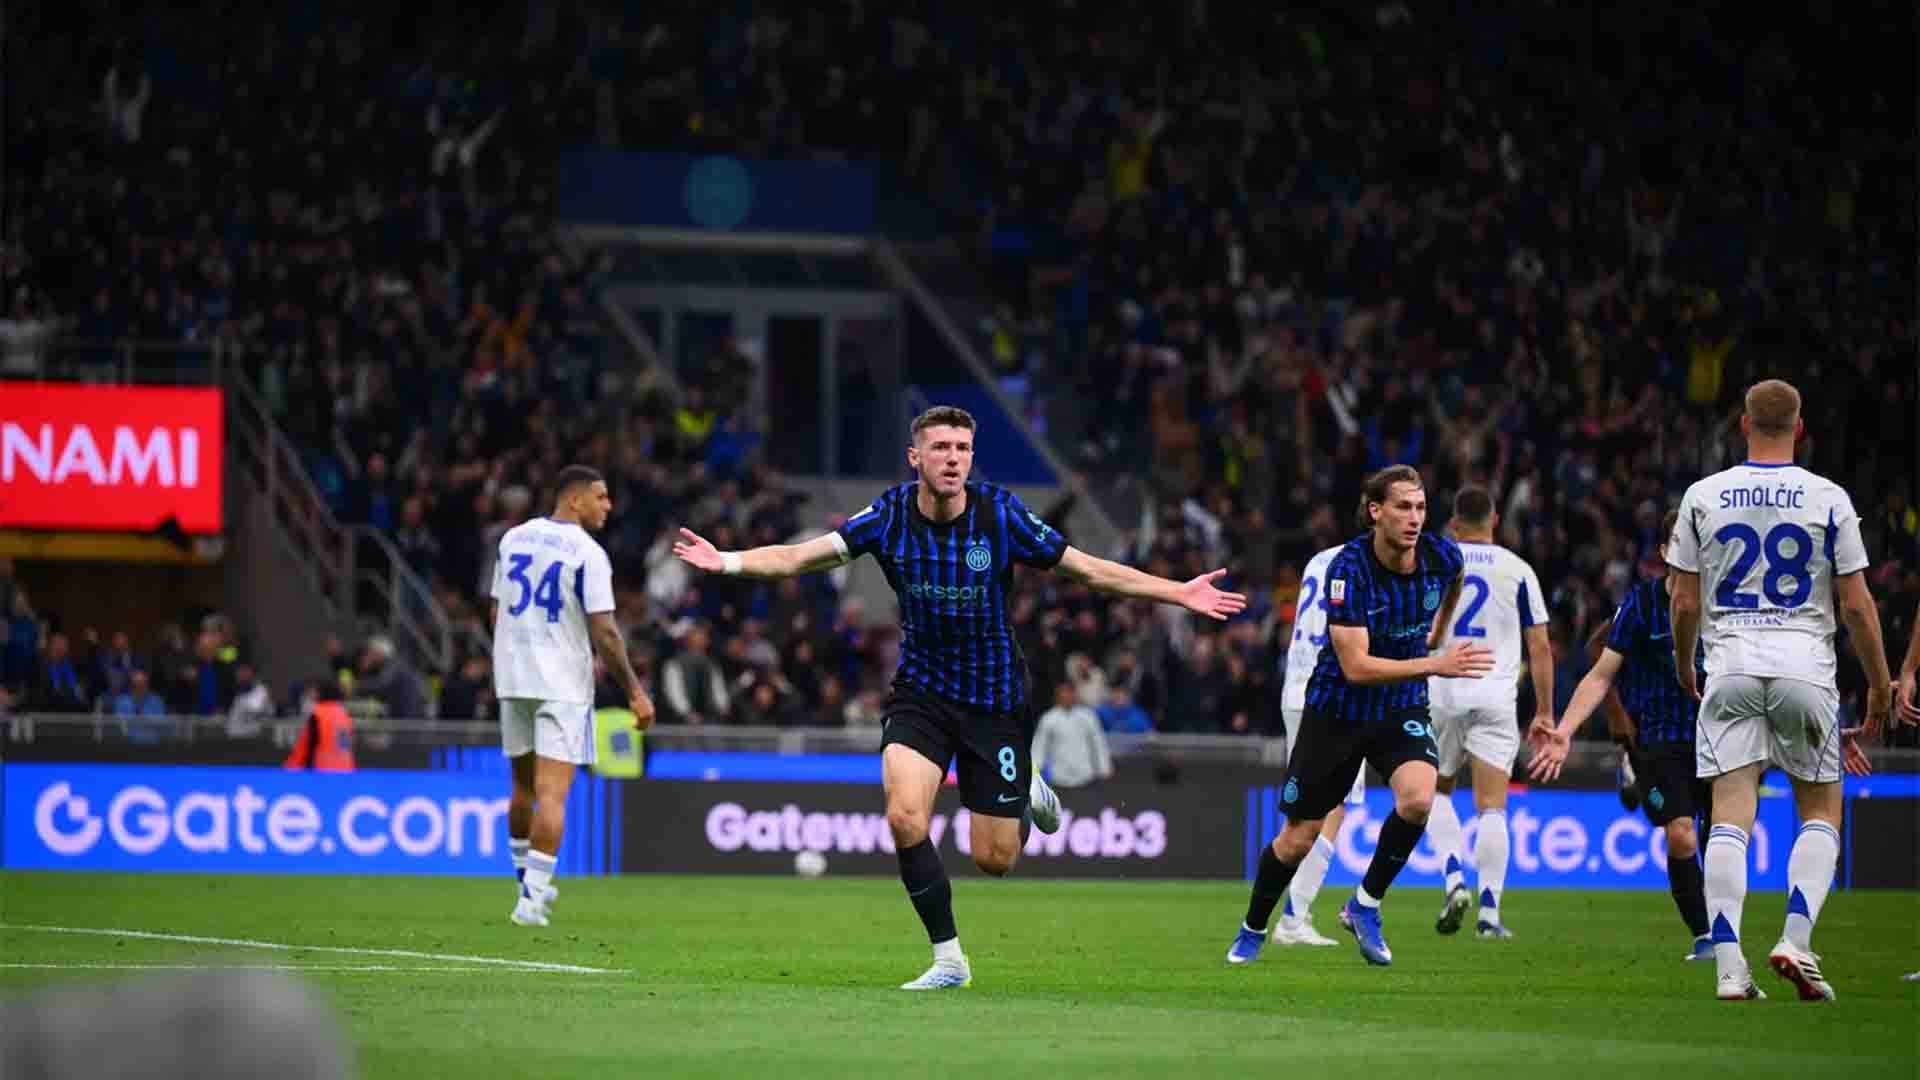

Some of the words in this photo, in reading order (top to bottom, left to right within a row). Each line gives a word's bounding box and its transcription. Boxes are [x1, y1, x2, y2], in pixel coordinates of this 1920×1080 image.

[1720, 483, 1806, 509] SMOLČIĆ
[508, 553, 564, 624] 34
[905, 579, 987, 601] etsson
[1715, 523, 1813, 609] 28
[1454, 575, 1490, 638] 2
[998, 746, 1017, 782] 8
[108, 786, 511, 857] Gate.com
